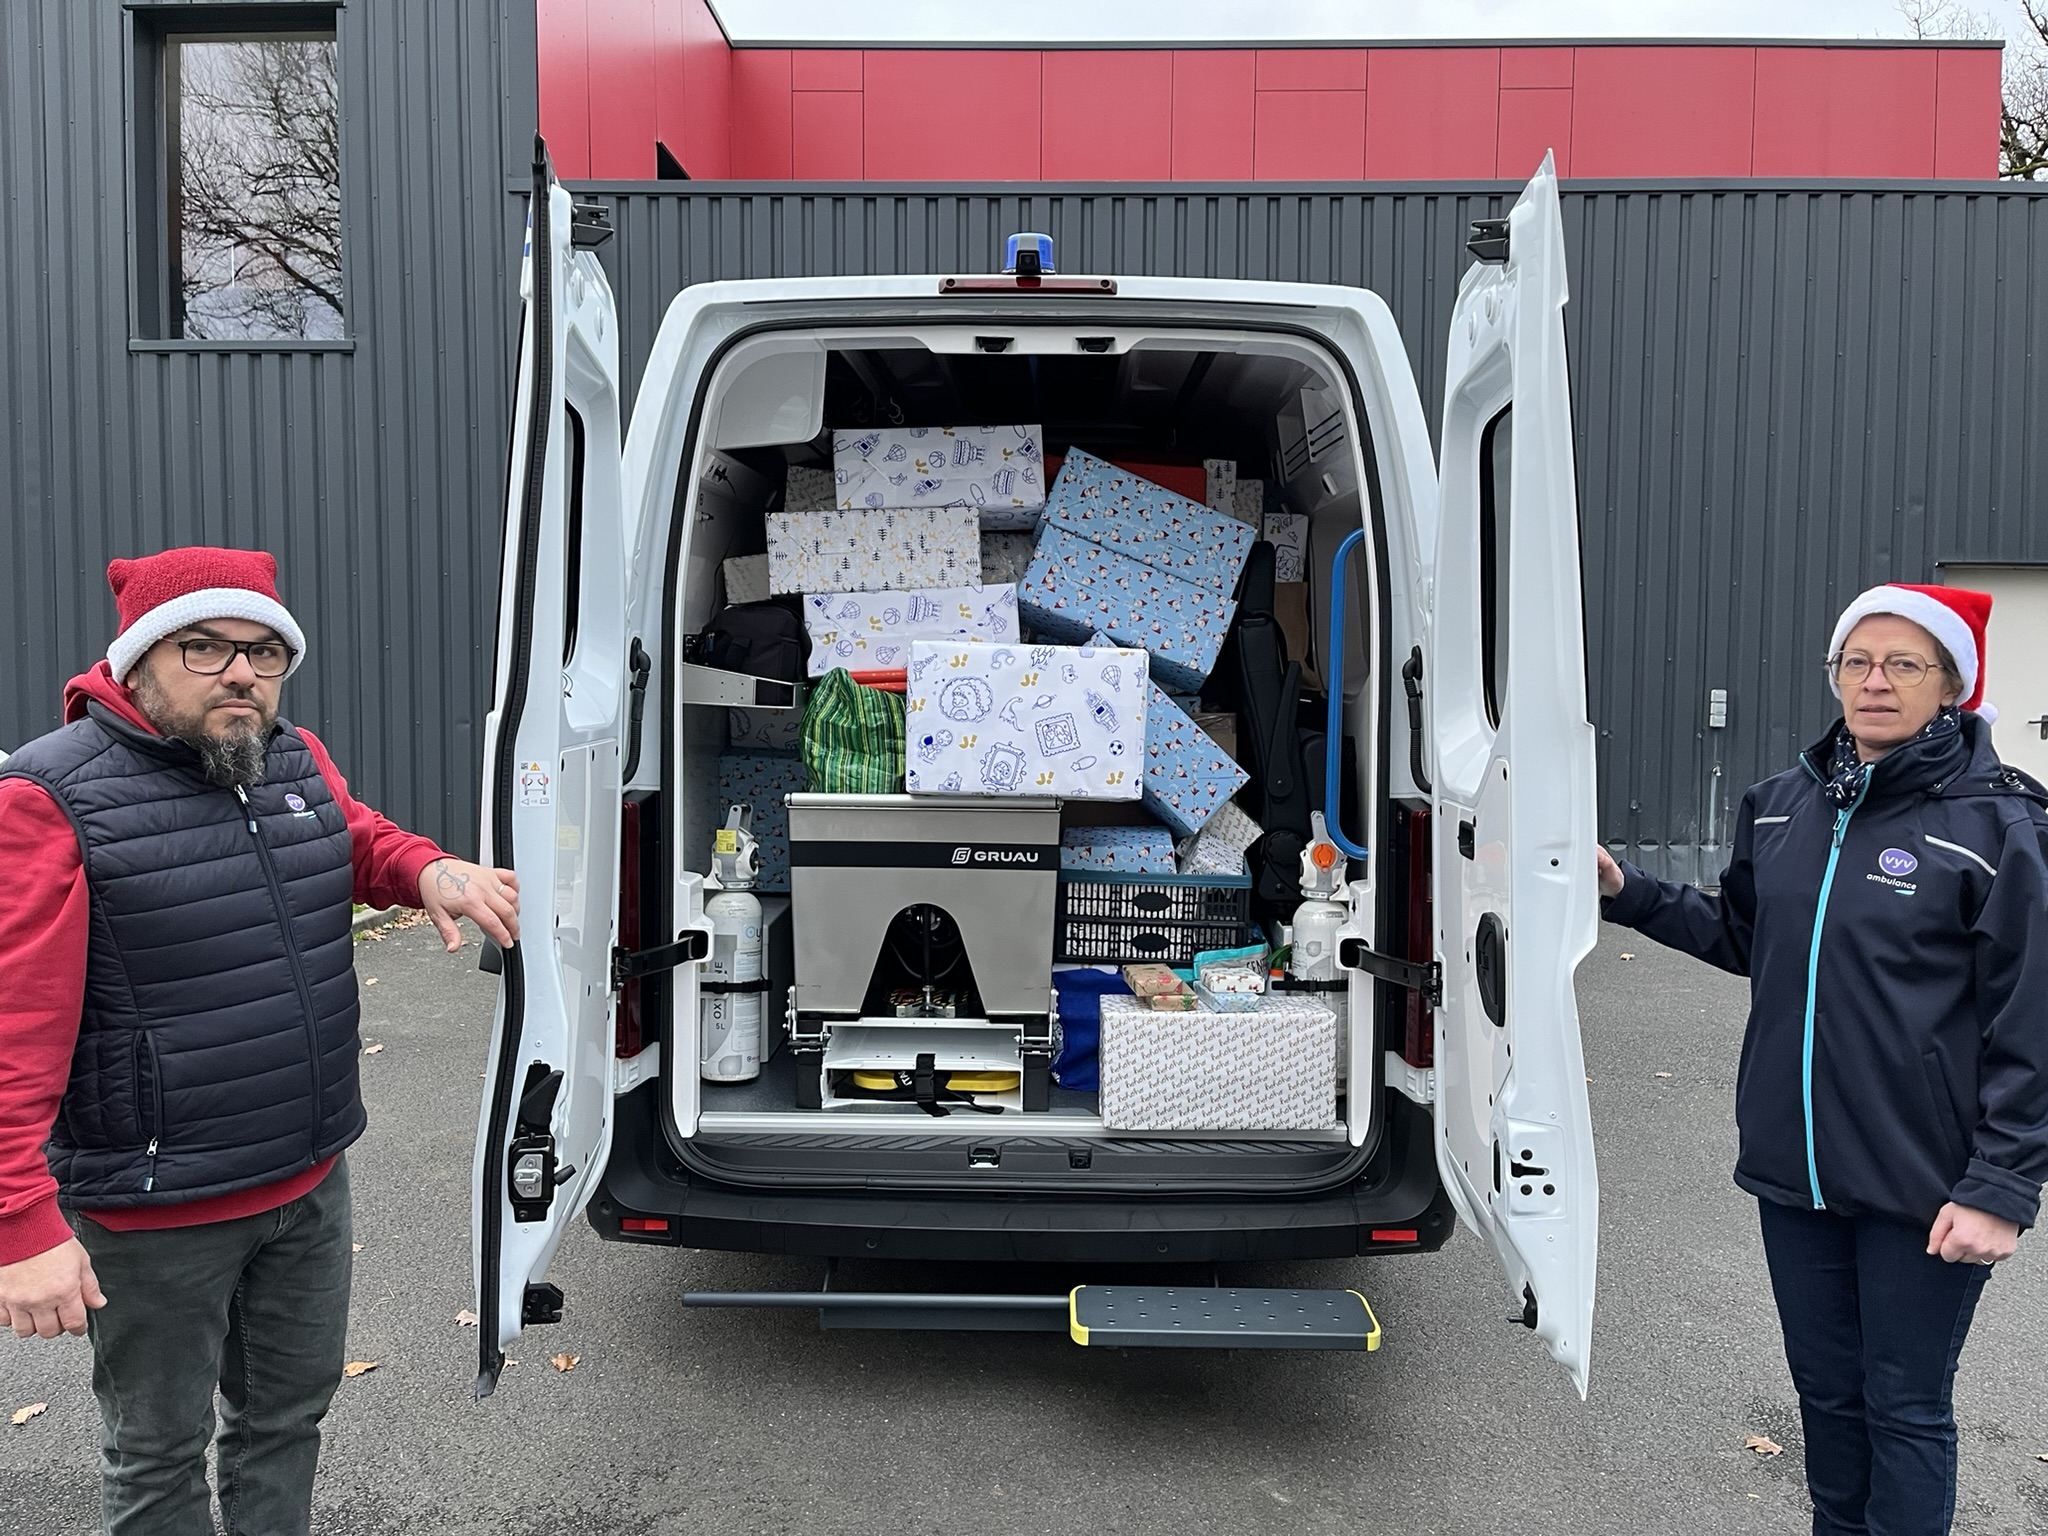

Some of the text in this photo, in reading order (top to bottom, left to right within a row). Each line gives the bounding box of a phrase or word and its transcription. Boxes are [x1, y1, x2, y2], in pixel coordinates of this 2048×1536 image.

[974, 851, 1039, 862] GRUAU
[1886, 855, 1913, 869] vyv
[1866, 874, 1917, 890] ambulance
